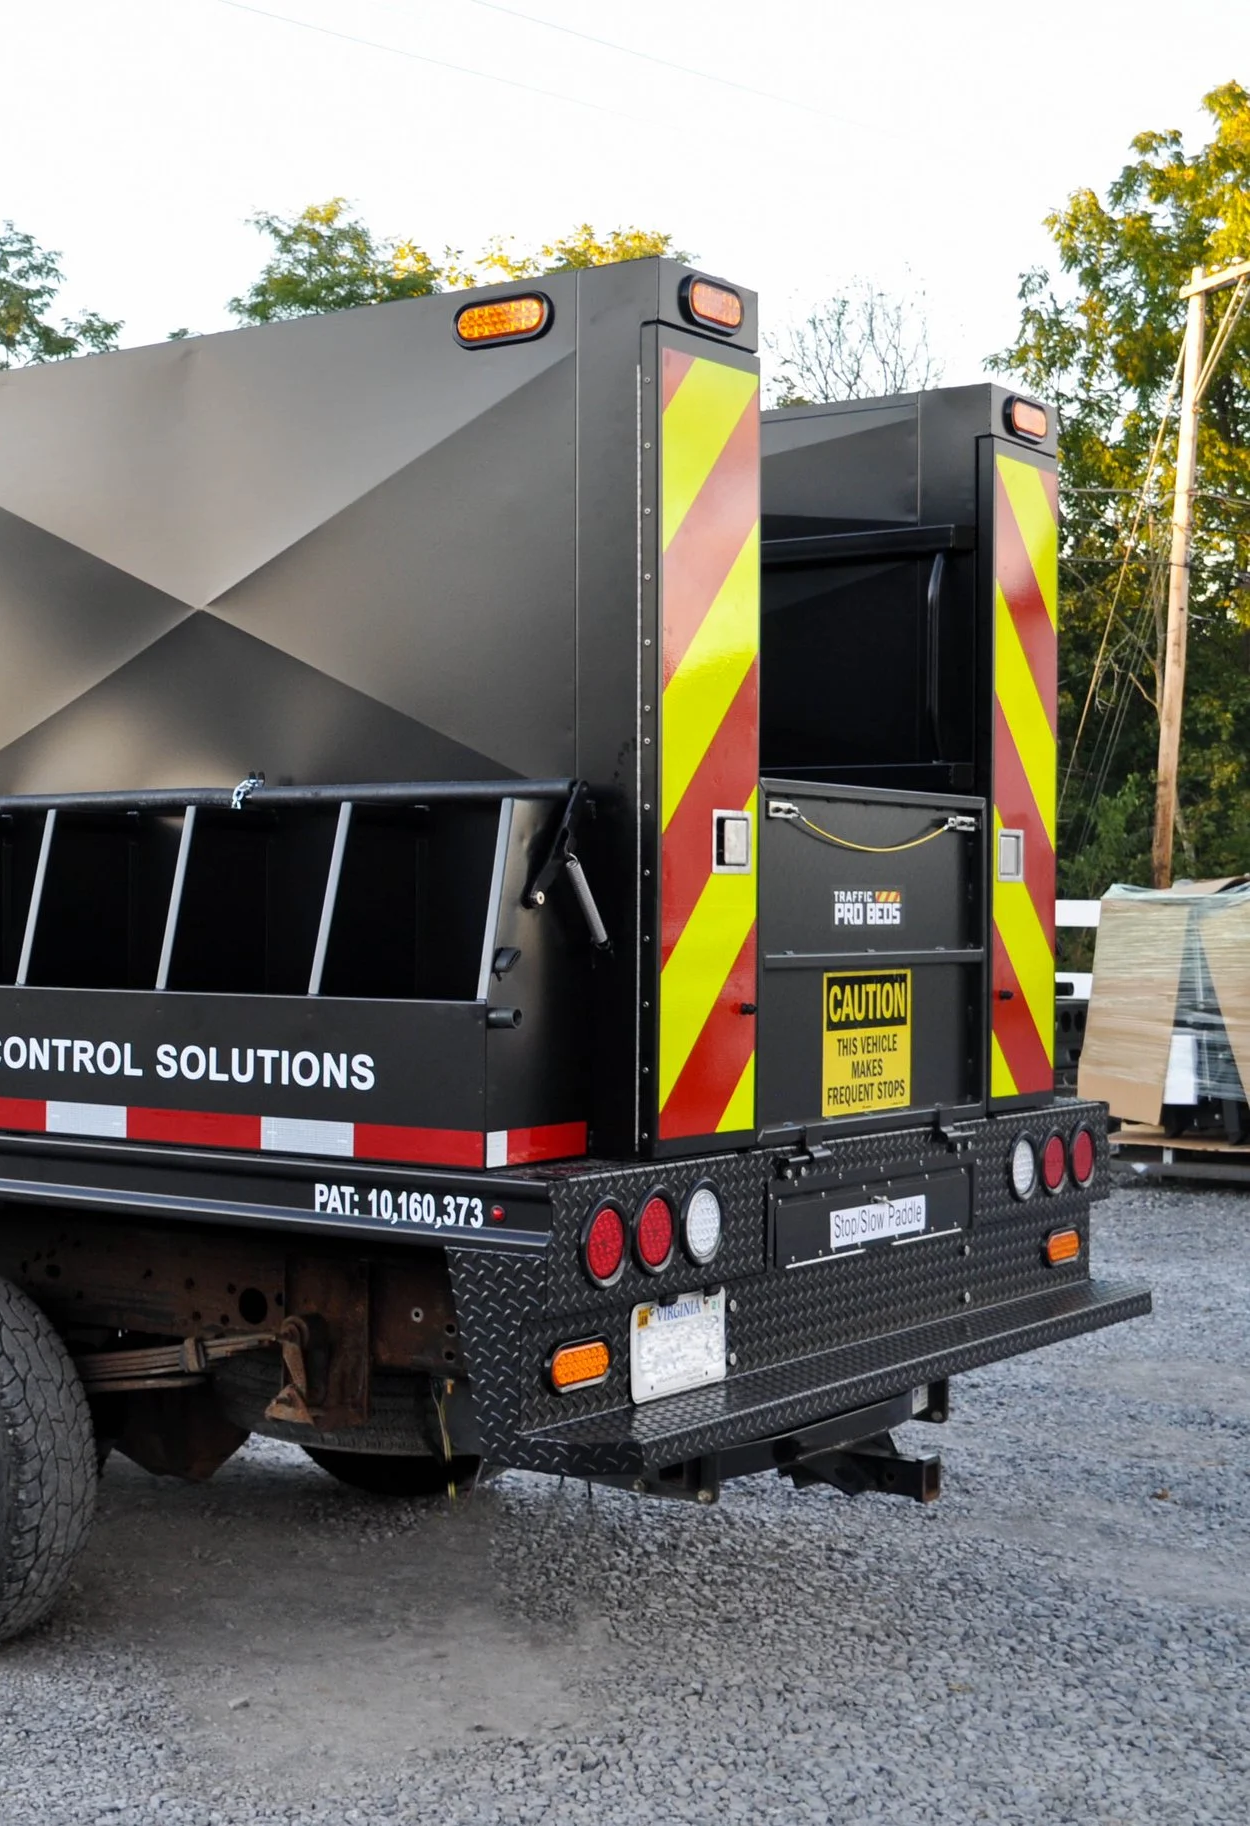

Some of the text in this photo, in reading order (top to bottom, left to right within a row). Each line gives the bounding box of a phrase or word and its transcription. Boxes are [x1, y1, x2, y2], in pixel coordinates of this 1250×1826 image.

[833, 890, 873, 902] TRAFFIC
[834, 902, 901, 925] PRO BEDS
[829, 981, 906, 1023] CAUTION
[837, 1033, 898, 1057] THIS VEHICLE
[155, 1044, 376, 1091] SOLUTIONS
[851, 1058, 883, 1079] MAKES
[827, 1079, 905, 1107] FREQUENT STOPS
[314, 1183, 484, 1229] PAT: 10,160,373
[834, 1201, 922, 1242] Stop/Slow Paddle
[656, 1299, 701, 1321] VIRGINIA
